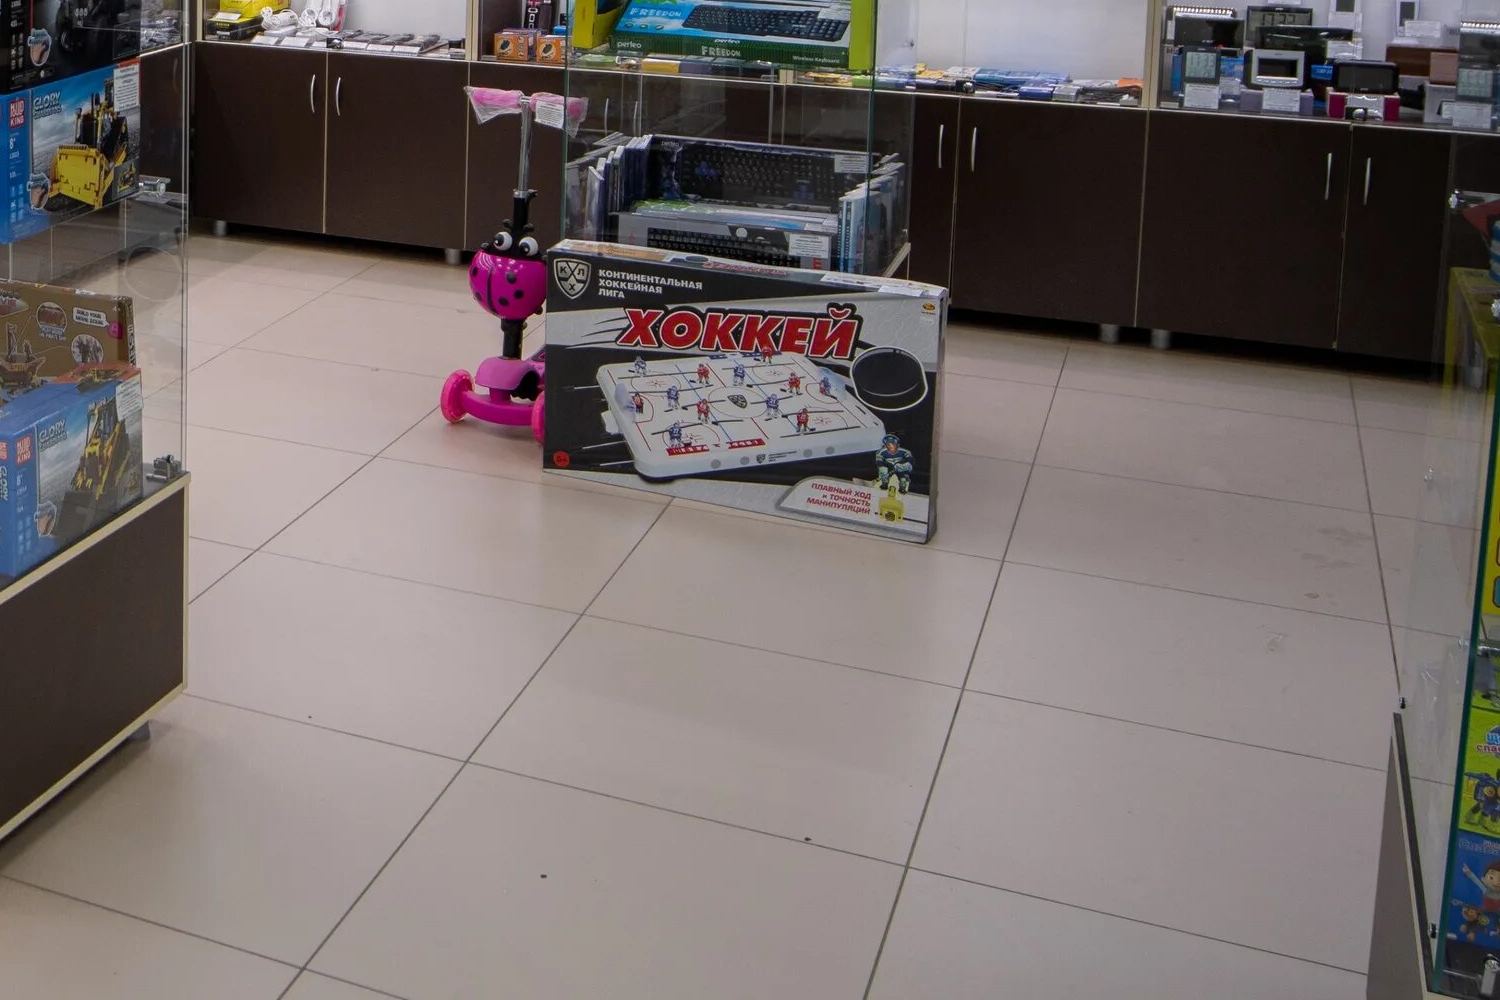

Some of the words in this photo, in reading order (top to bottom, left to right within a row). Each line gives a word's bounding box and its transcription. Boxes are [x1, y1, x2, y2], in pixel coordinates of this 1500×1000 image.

[629, 7, 682, 17] FREEDOM
[617, 40, 642, 49] perfeo
[701, 45, 742, 58] FREEDOM
[599, 269, 703, 290] КОНТИНЕНТАЛЬНАЯ
[599, 278, 663, 294] ХОККЕЙНАЯ
[598, 287, 625, 299] ЛИГА
[615, 304, 860, 361] ХОККЕЙ
[811, 481, 852, 496] ПЛАВНЫЙ
[853, 490, 872, 500] ХОД
[806, 497, 871, 515] МАНИПУЛЯЦИЙ
[829, 493, 871, 507] ТОЧНОСТЬ
